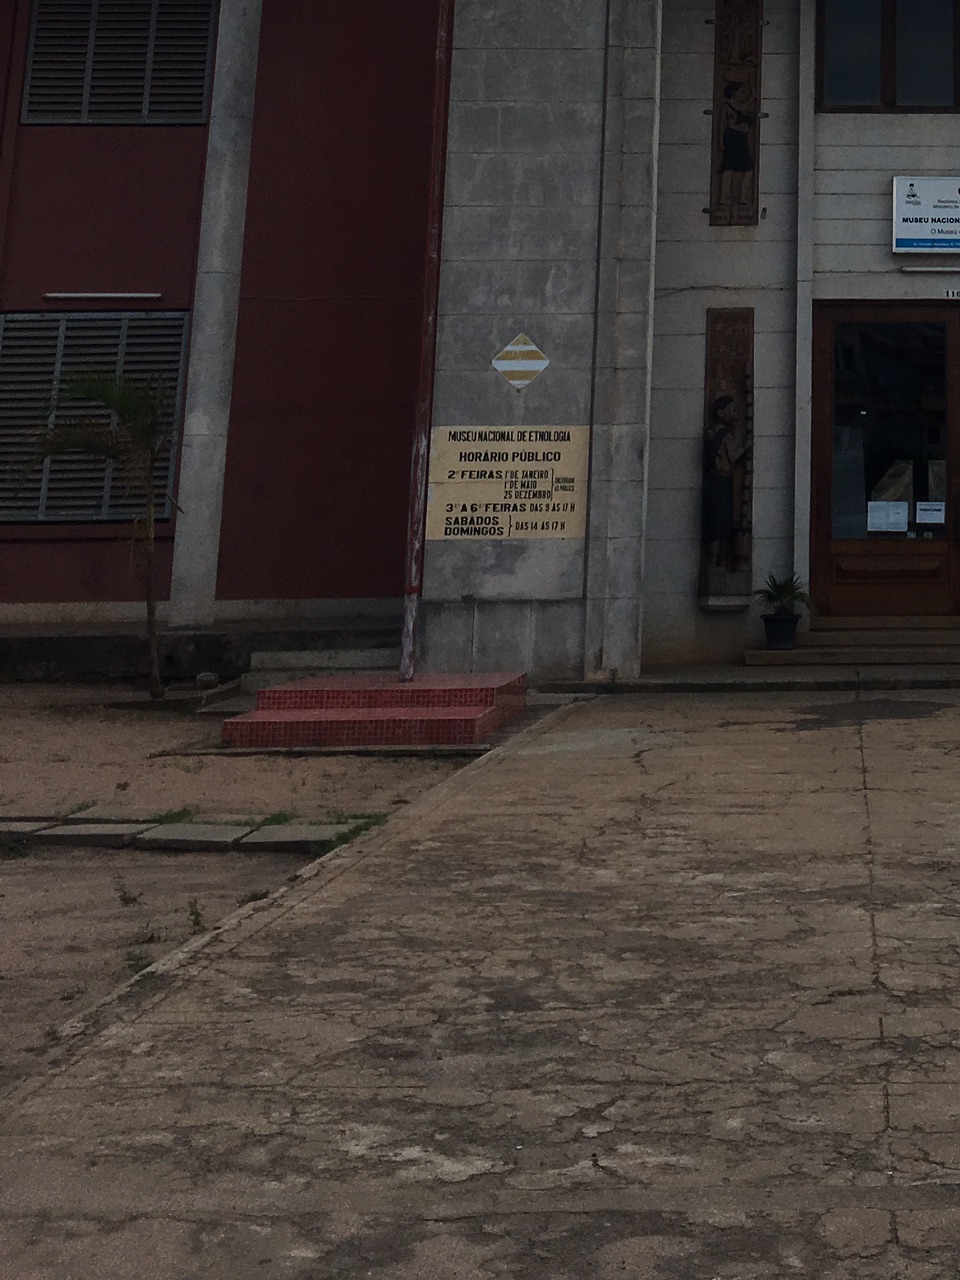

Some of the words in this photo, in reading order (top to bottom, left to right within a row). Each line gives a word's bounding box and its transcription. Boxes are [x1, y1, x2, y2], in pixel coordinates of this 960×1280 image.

[448, 430, 477, 442] MUSEU
[478, 430, 516, 442] NACIONAL
[517, 430, 527, 442] DE
[528, 430, 571, 442] ETNOLOGIA
[459, 449, 508, 462] HORÁRIO
[511, 449, 561, 462] PÚBLICO
[460, 470, 503, 479] FEIRAS
[510, 470, 519, 479] DE
[521, 470, 549, 479] JANEIRO
[510, 480, 519, 489] DE
[520, 480, 537, 489] MAIO
[503, 491, 513, 499] 25
[515, 490, 551, 499] DEZEMBRO
[460, 504, 467, 512] A
[485, 503, 526, 512] FEIRAS
[529, 503, 543, 512] DAS
[545, 503, 550, 512] 9
[562, 503, 568, 512] 17
[570, 503, 575, 512] H
[515, 521, 529, 531] DAS
[531, 521, 538, 531] 14
[551, 521, 559, 531] 17
[560, 521, 565, 530] H
[443, 527, 504, 536] DOMINGOS
